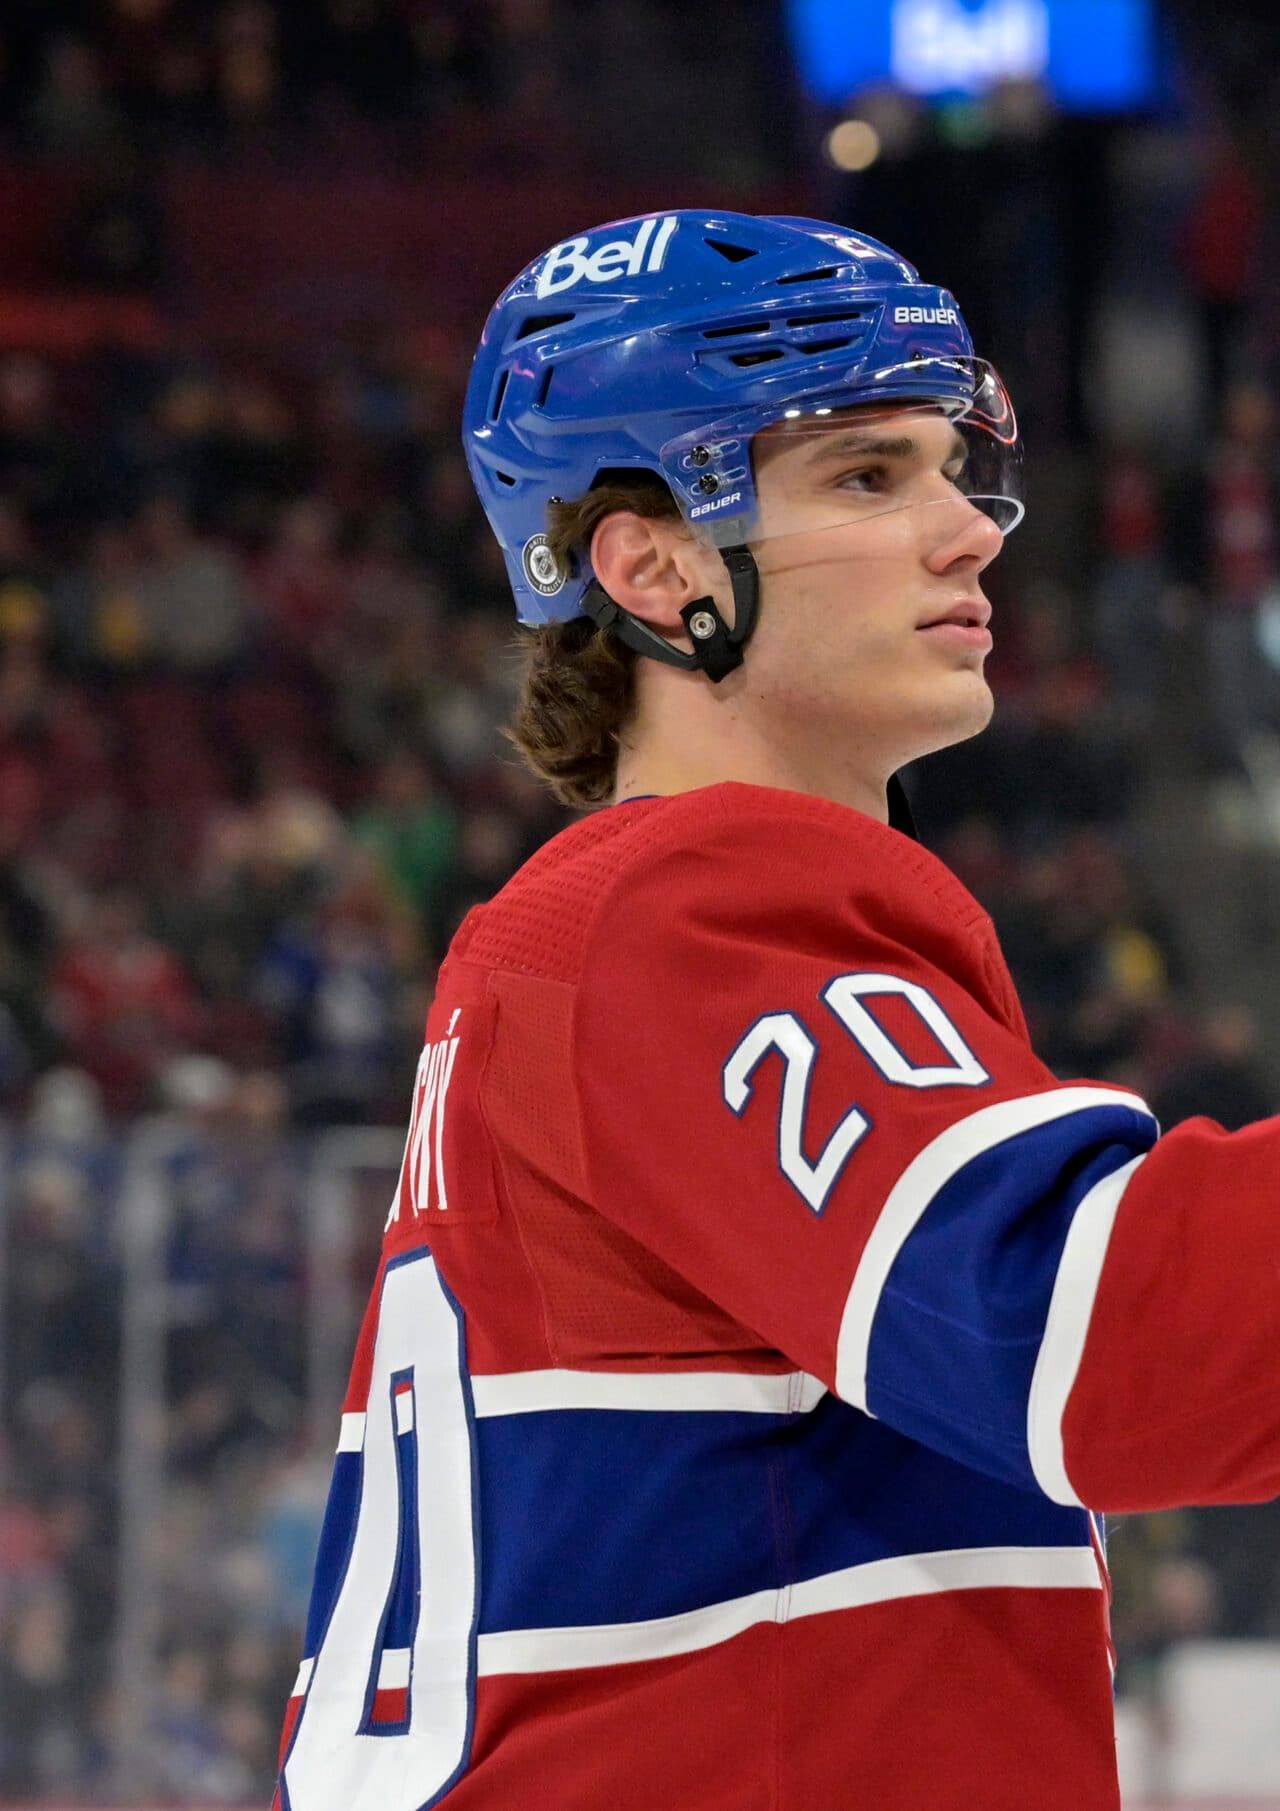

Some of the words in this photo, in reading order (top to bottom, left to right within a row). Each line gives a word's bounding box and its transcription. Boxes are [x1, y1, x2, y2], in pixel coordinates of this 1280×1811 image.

[537, 216, 678, 300] Bell
[894, 306, 959, 326] BAUER
[690, 492, 741, 519] BAUER
[720, 970, 993, 1219] 20
